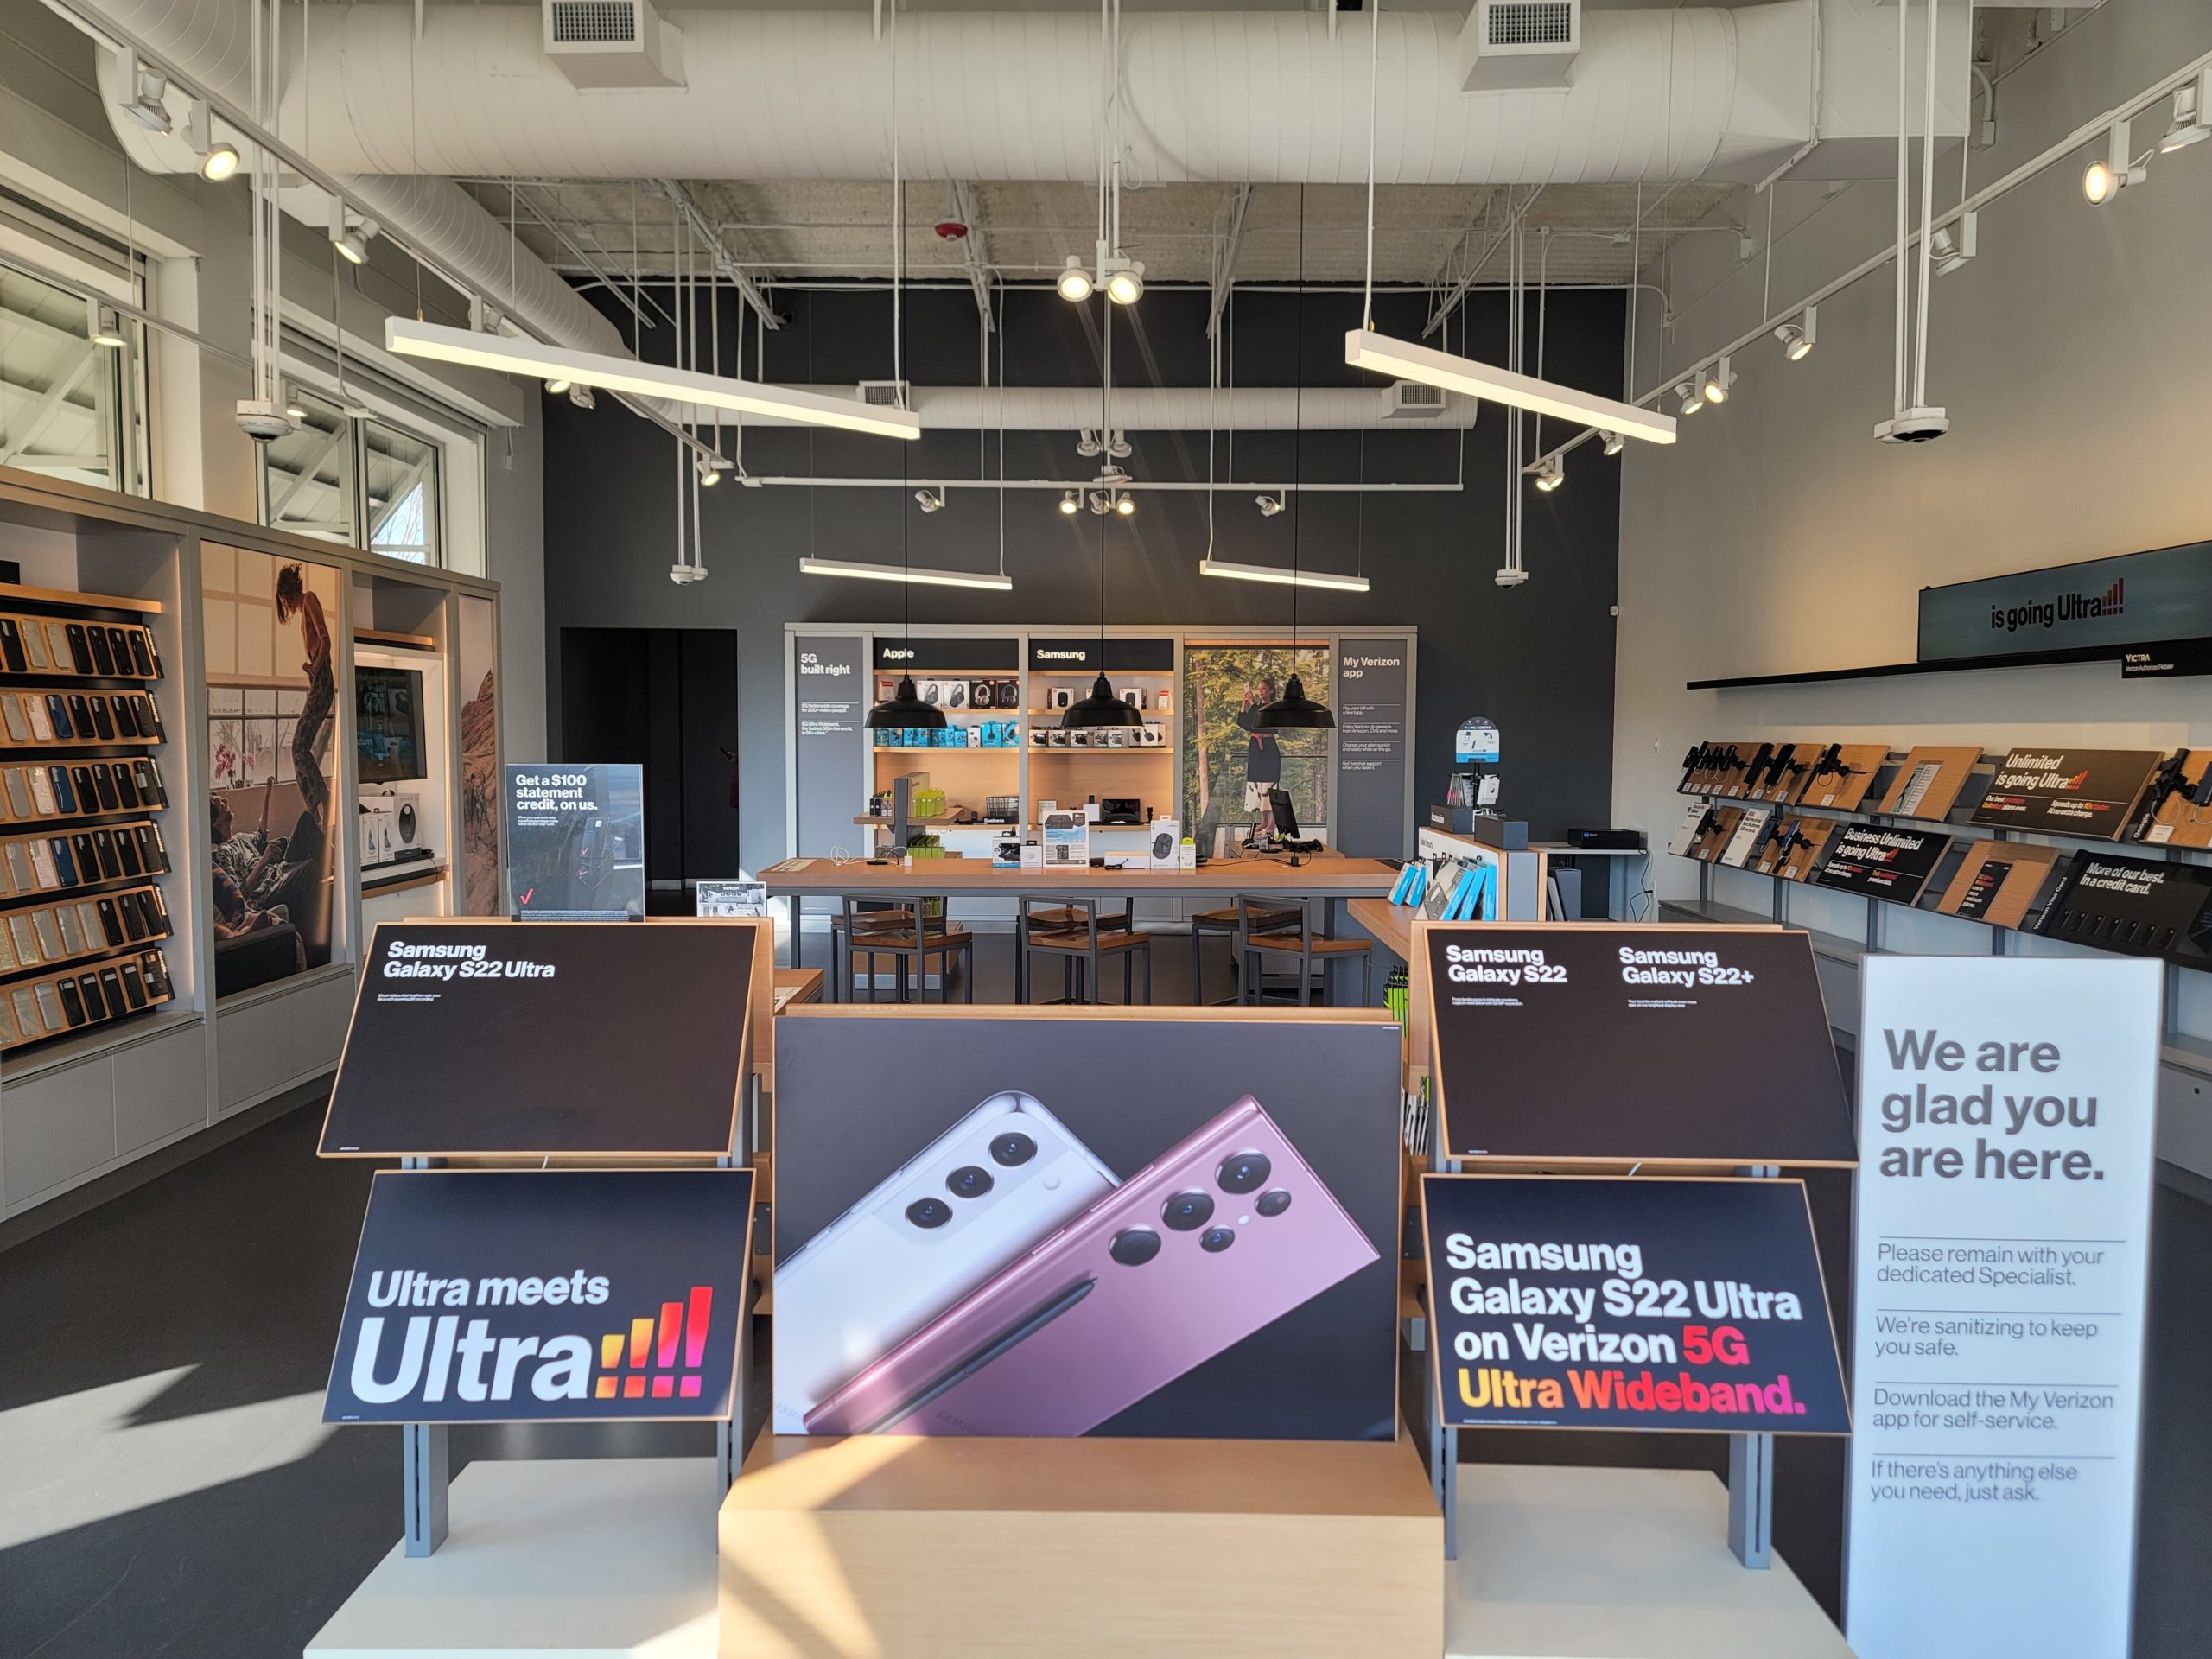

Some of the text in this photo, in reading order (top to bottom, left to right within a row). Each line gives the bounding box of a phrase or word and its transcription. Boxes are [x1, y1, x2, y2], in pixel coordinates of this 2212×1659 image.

[1991, 606, 2005, 629] is
[2006, 600, 2054, 632] going
[800, 653, 817, 664] 5G
[883, 648, 914, 659] Apple
[1037, 650, 1086, 661] Samsung
[1343, 657, 1400, 668] My Verizon
[800, 664, 850, 677] built right
[1343, 670, 1363, 679] app
[2005, 753, 2064, 770] Unlimited
[515, 773, 587, 787] Get a $100
[1995, 771, 2006, 785] is
[2005, 772, 2038, 791] going
[516, 787, 583, 798] statement
[517, 798, 598, 812] credit, on us.
[2133, 812, 2151, 839] Google
[1844, 828, 1925, 851] Business Unlimited
[1835, 842, 1844, 855] is
[1842, 844, 1866, 860] going
[2087, 862, 2165, 884] More of our best.
[2079, 874, 2151, 895] In a credit card.
[2033, 876, 2068, 930] Verizon Visa Card
[388, 941, 487, 961] Samsung
[1446, 944, 1545, 968] Samsung
[1618, 946, 1719, 969] Samsung
[384, 961, 556, 982] Galaxy S22 Ultra
[1447, 964, 1568, 987] Galaxy S22
[1622, 966, 1755, 988] Galaxy S22+
[1882, 1028, 2061, 1073] We are
[1881, 1083, 2097, 1135] glad you
[1879, 1138, 2104, 1181] are here.
[1446, 1232, 1643, 1280] Samsung
[1878, 1243, 2105, 1268] Please remain with your
[1877, 1265, 2075, 1287] dedicated Specialist.
[366, 1269, 610, 1307] Ultra meets
[1450, 1276, 1804, 1324] Galaxy S22 Ultra
[1876, 1316, 2098, 1340] We're sanitizing to keep
[1454, 1322, 1751, 1366] on Verizon 5G
[1875, 1338, 1959, 1357] you safe.
[1458, 1368, 1807, 1414] Ultra Wideband.
[1874, 1389, 2113, 1411] Download the My Verizon
[1872, 1410, 2057, 1430] app for self-service.
[1871, 1460, 2078, 1484] If there's anything else
[1870, 1484, 2039, 1503] you need, just ask.
